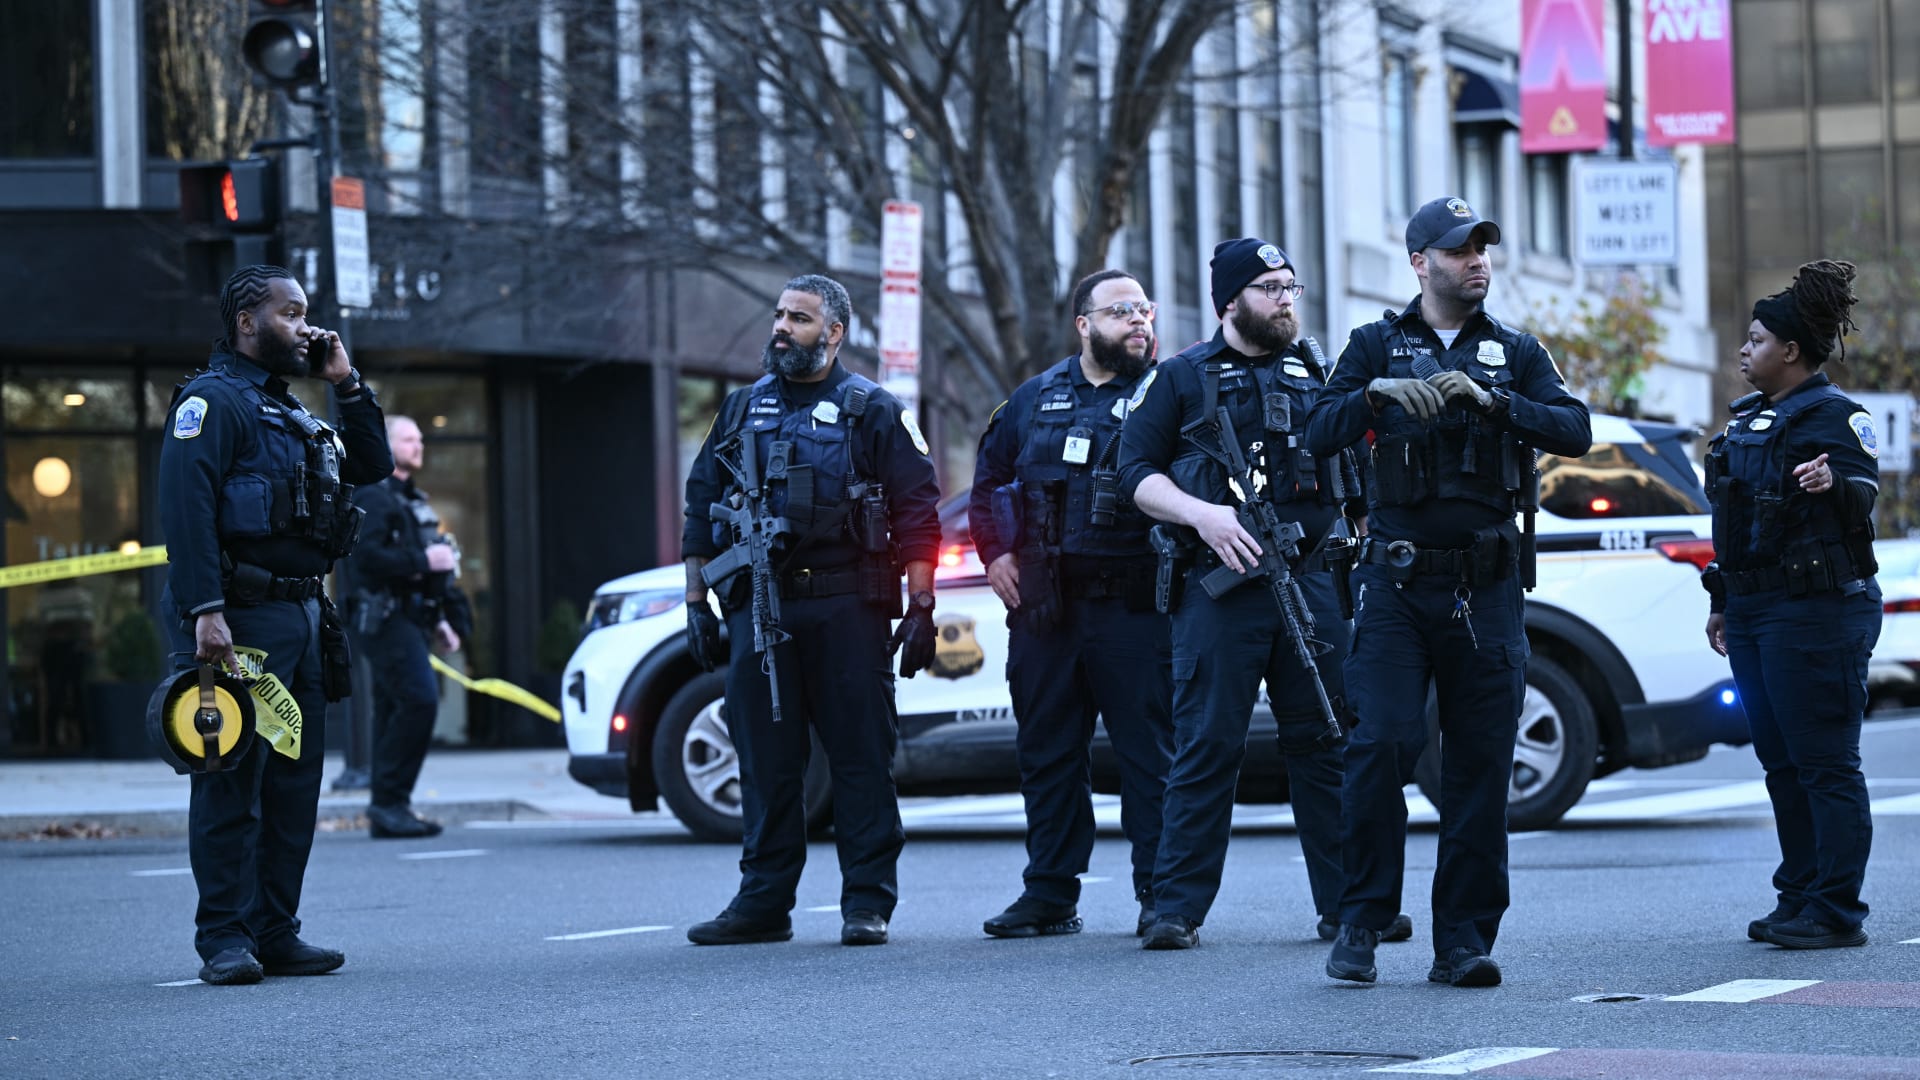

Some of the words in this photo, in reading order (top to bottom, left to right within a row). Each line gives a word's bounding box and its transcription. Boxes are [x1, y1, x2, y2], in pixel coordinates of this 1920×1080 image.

[1650, 11, 1723, 42] AVE
[1584, 175, 1621, 193] LEFT
[1627, 174, 1666, 191] LANE
[1598, 203, 1654, 223] MUST
[1586, 235, 1625, 252] TURN
[1632, 234, 1670, 252] LEFT
[1599, 530, 1646, 550] 4143
